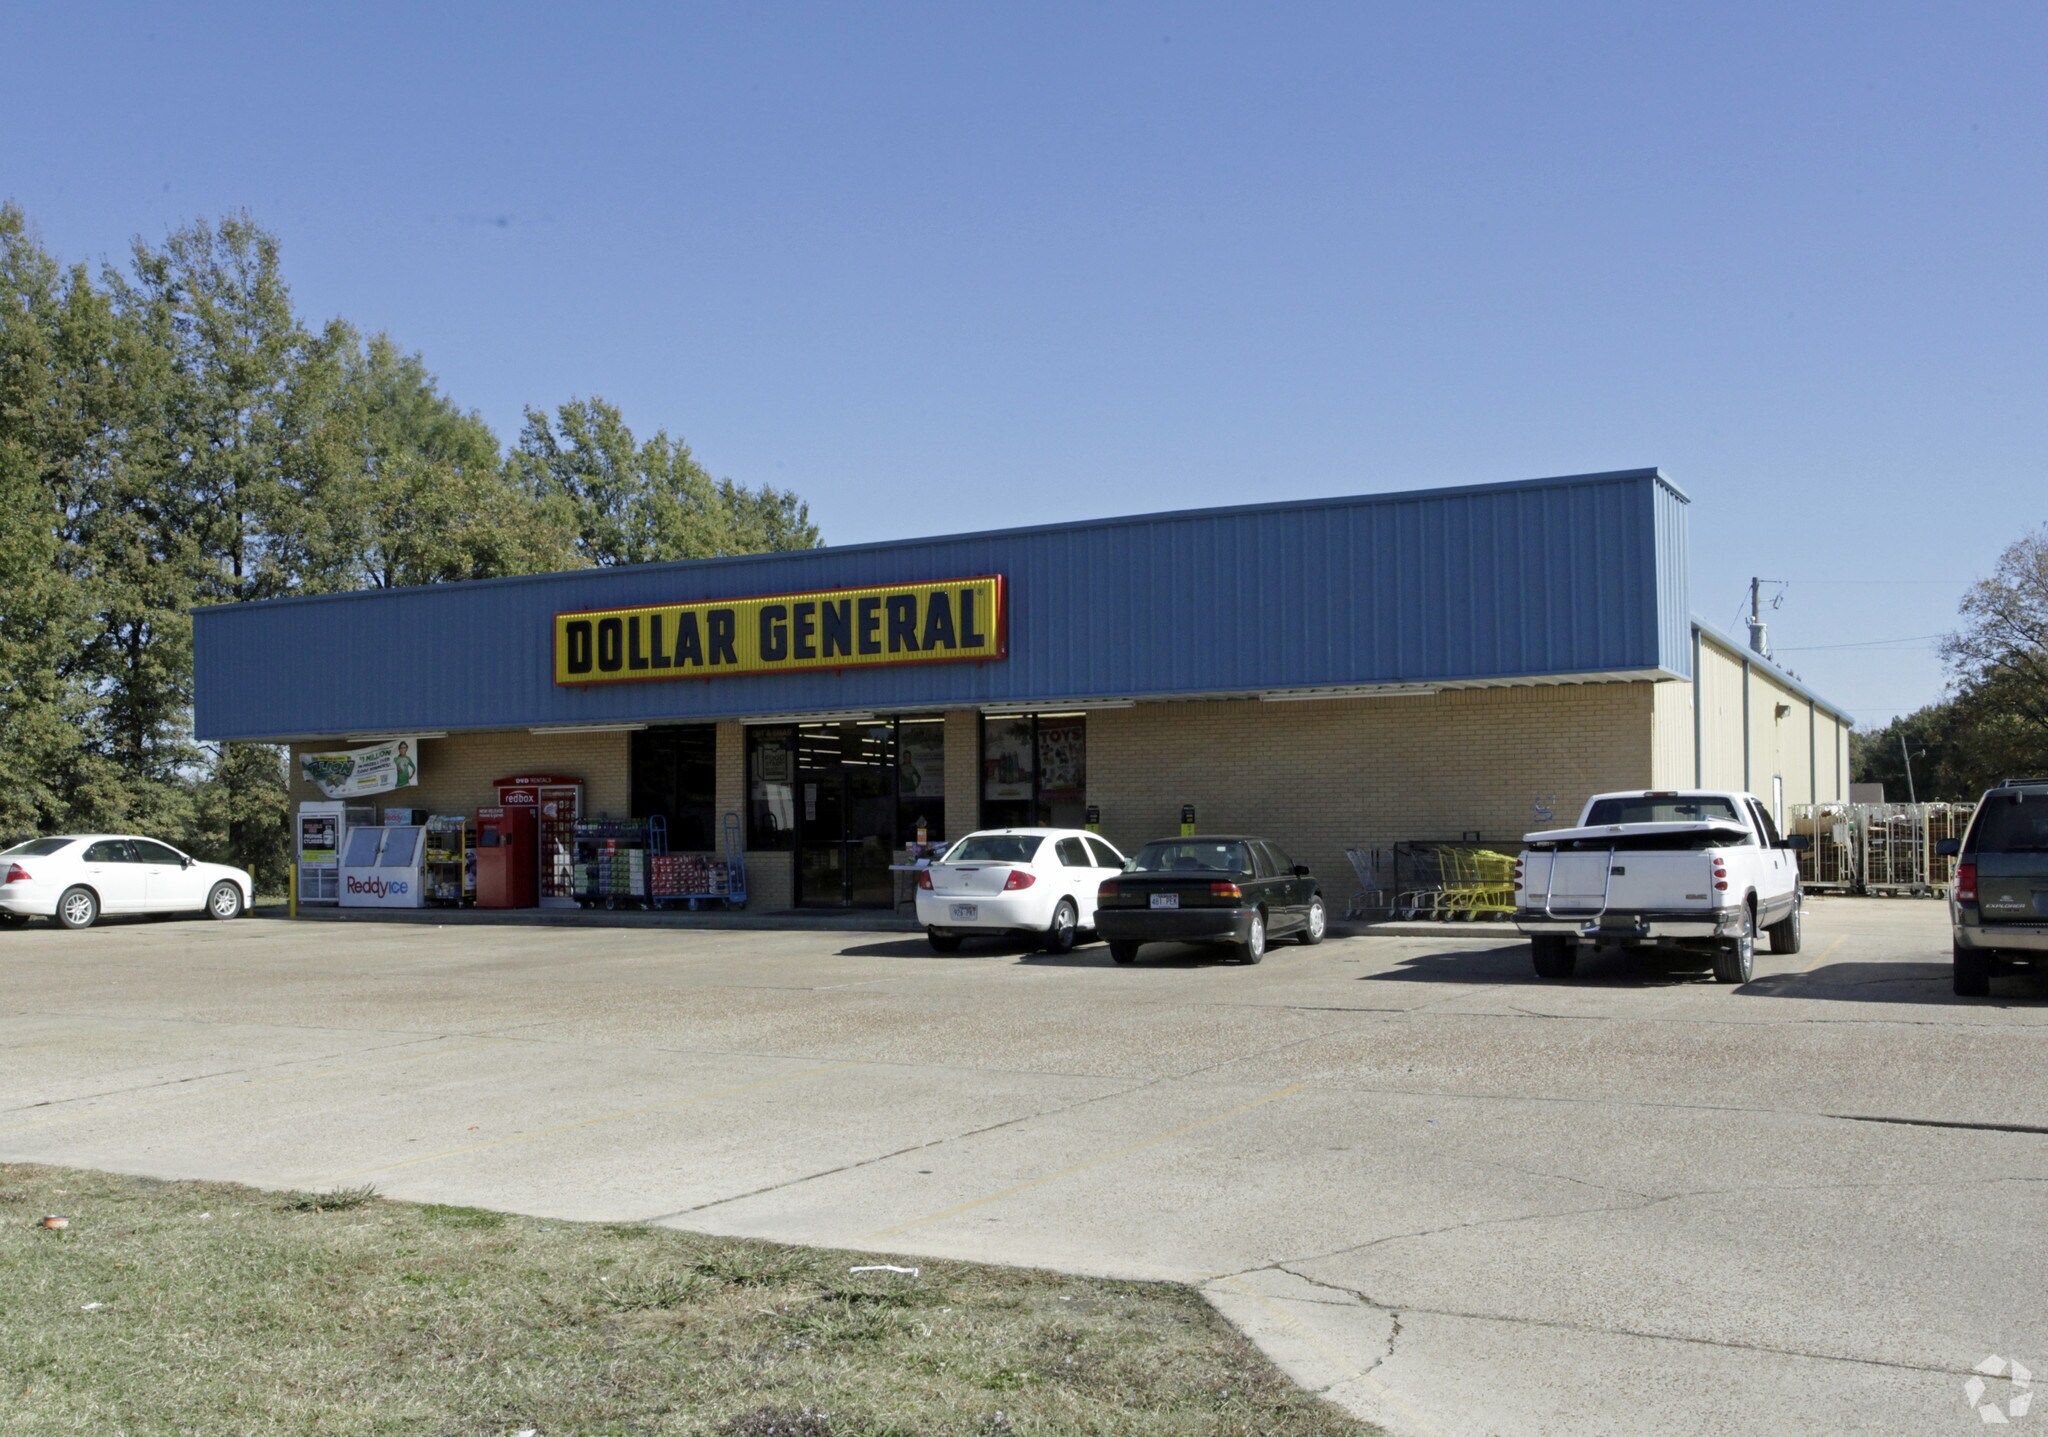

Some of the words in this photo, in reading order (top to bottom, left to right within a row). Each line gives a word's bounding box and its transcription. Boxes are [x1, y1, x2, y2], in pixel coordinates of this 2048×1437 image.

[566, 608, 738, 674] DOLLAR
[760, 589, 985, 662] GENERAL
[1039, 727, 1082, 743] TOYS
[505, 794, 534, 803] redbox
